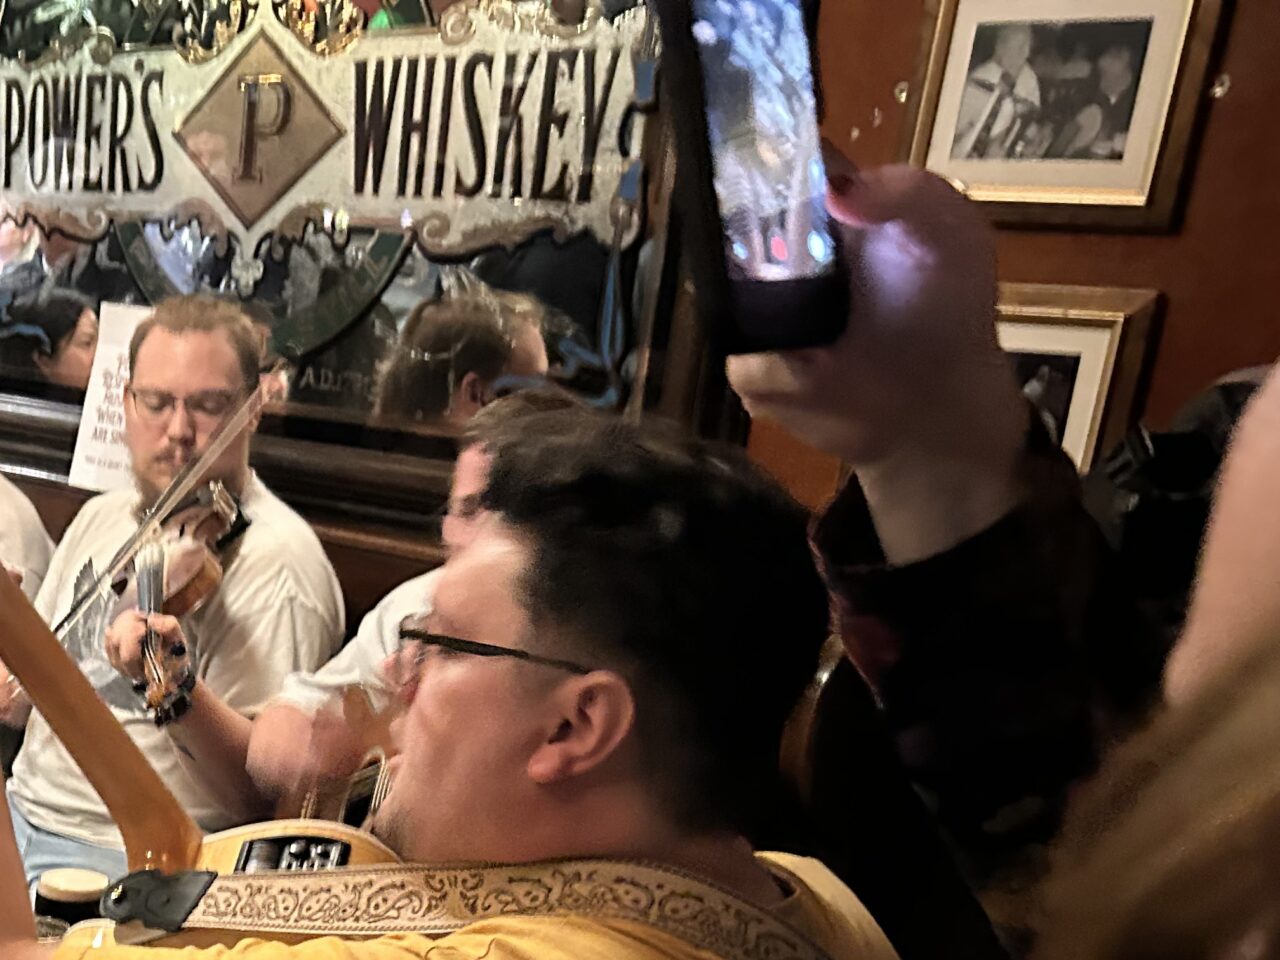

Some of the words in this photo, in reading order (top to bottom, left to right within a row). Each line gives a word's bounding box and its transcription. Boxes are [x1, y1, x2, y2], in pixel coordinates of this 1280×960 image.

[3, 58, 164, 193] POWER'S
[231, 73, 292, 184] P
[353, 46, 622, 203] WHISKEY
